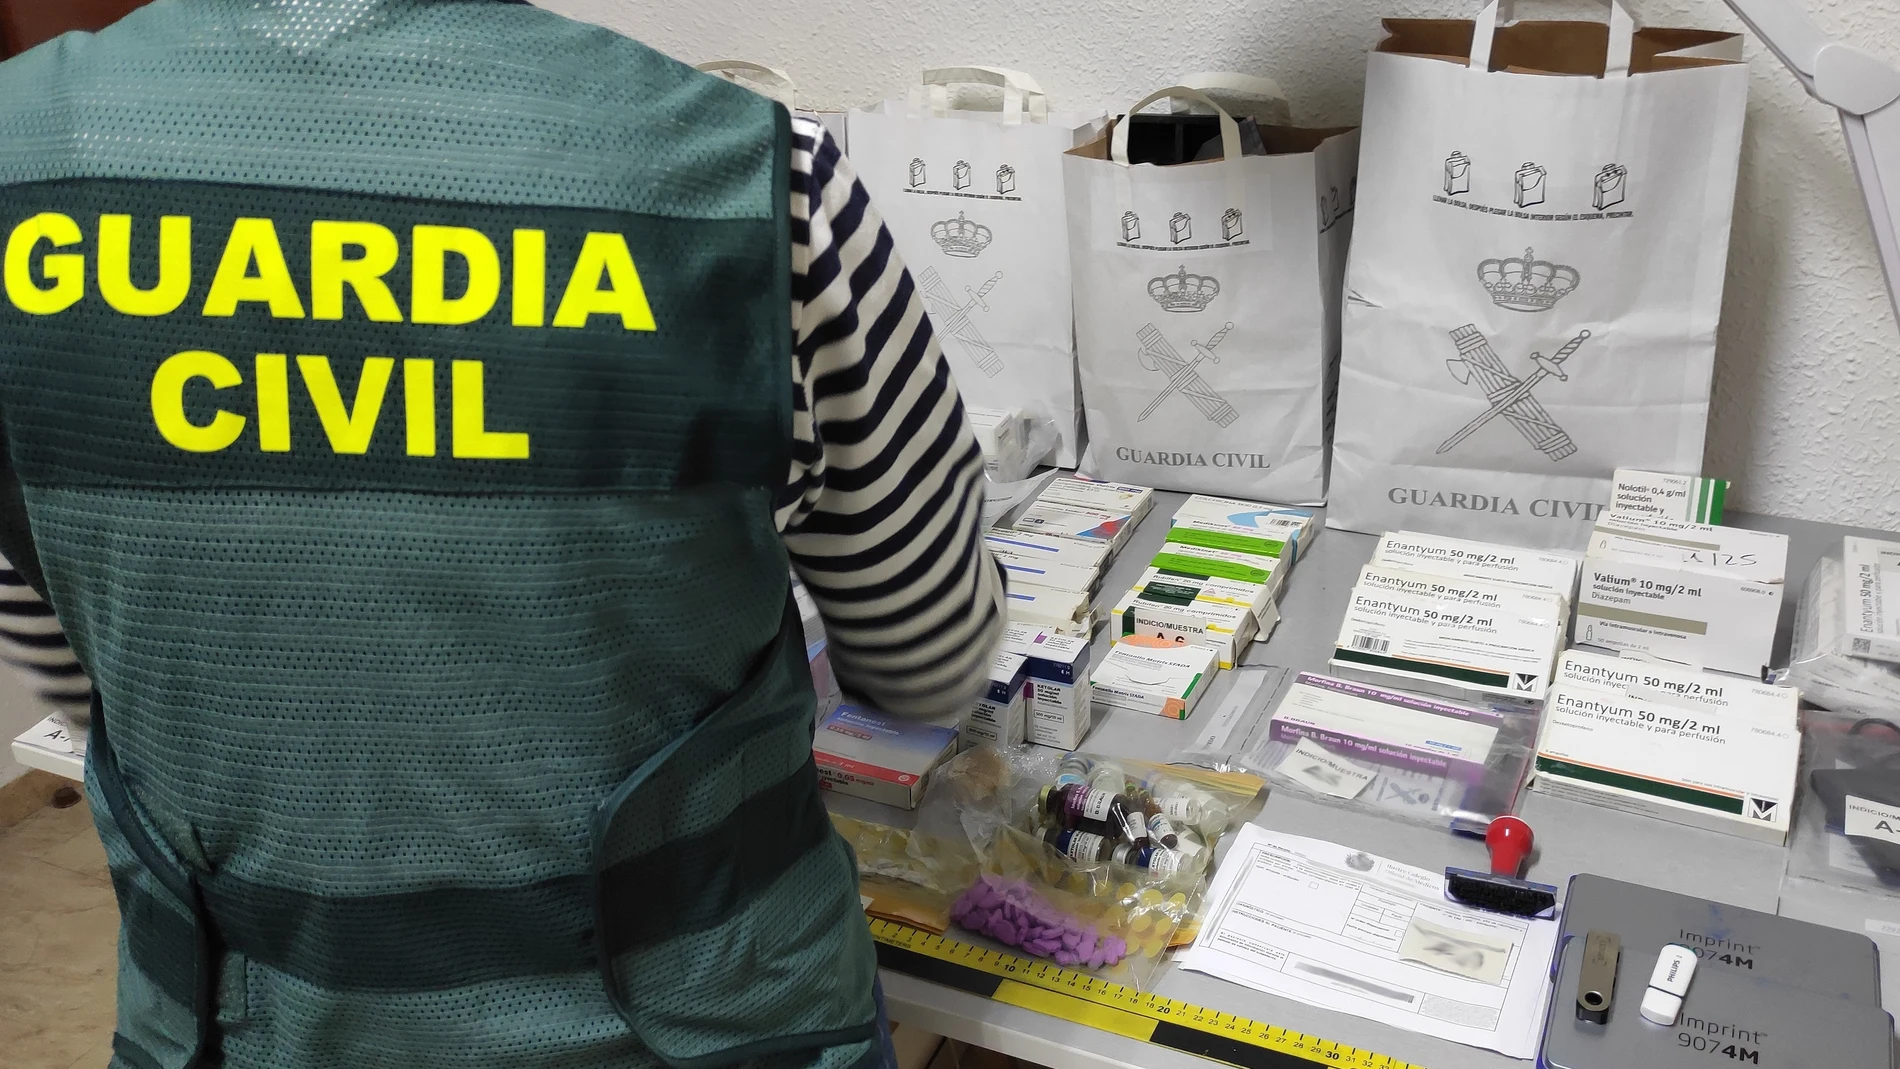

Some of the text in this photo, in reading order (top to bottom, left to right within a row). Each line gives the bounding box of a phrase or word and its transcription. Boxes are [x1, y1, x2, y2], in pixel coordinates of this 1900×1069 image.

[4, 212, 657, 331] GUARDIA
[150, 350, 529, 459] CIVIL
[1116, 446, 1271, 470] GUARDIA CIVIL
[1388, 487, 1520, 516] GUARDIA
[1616, 492, 1653, 503] solución
[1650, 486, 1665, 496] 0,4
[1665, 489, 1687, 499] g/ml
[1615, 501, 1665, 515] inyectable y
[1385, 548, 1415, 558] solución
[1416, 553, 1455, 563] inyectable
[1462, 559, 1481, 567] para
[1481, 562, 1519, 572] perfusión
[1386, 540, 1516, 565] Enantyum 50 mg/2 ml
[1205, 582, 1255, 594] comprimidos
[1363, 580, 1395, 591] solución
[1396, 587, 1436, 599] inyectable
[1443, 595, 1461, 604] para
[1462, 597, 1501, 609] perfusión
[1364, 572, 1498, 602] Enantyum 50 mg/2 ml
[1591, 591, 1631, 605] Diazepam
[1592, 583, 1665, 601] solución inyectable
[1639, 579, 1653, 590] 10
[1655, 583, 1685, 596] mg/2
[1687, 588, 1702, 597] ml
[1186, 608, 1237, 620] comprimidos
[1354, 605, 1387, 616] solución
[1388, 612, 1430, 624] inyectable
[1437, 621, 1456, 629] para
[1457, 623, 1498, 634] perfusión
[1355, 595, 1493, 627] Enantyum 50 mg/2 ml
[1136, 617, 1204, 635] INDICIO/MUESTRA
[1563, 671, 1601, 685] solución
[1564, 660, 1723, 698] Enantyum 50 mg/2 ml
[1307, 676, 1335, 687] Morfina
[1344, 684, 1366, 694] Braun
[1379, 693, 1403, 702] mg/ml
[1403, 697, 1432, 709] solución
[1432, 704, 1470, 717] inyectable
[841, 711, 886, 727] Fentanest
[1555, 705, 1594, 719] solución
[1596, 712, 1645, 729] inyectable
[1654, 726, 1676, 736] para
[1679, 730, 1726, 745] perfusión
[1557, 693, 1633, 718] Enantyum
[1637, 710, 1656, 722] 50
[1659, 716, 1697, 730] mg/2
[1701, 725, 1721, 735] ml
[1280, 724, 1447, 768] Morfina B. Braun 10 mg/ml solución inyectable
[1295, 747, 1369, 782] INDICIO/MUESTRA
[1680, 944, 1753, 970] 074M
[1666, 959, 1681, 983] PHILIPS
[1004, 963, 1016, 972] 10
[1036, 971, 1046, 980] 12
[1051, 975, 1060, 983] 13
[1066, 979, 1076, 988] 14
[1082, 983, 1091, 992] 15
[1097, 988, 1107, 996] 16
[1113, 992, 1123, 1000] 17
[1129, 997, 1139, 1005] 18
[1157, 1005, 1171, 1015] 20
[1175, 1009, 1186, 1017] 21
[1193, 1014, 1204, 1023] 22
[1208, 1018, 1219, 1026] 23
[1224, 1022, 1235, 1031] 24
[1240, 1027, 1251, 1035] 25
[1258, 1032, 1270, 1040] 26
[1275, 1036, 1287, 1044] 27
[1293, 1041, 1304, 1049] 28
[1310, 1046, 1322, 1054] 29
[1325, 1050, 1340, 1061] 30
[1345, 1055, 1356, 1063] 31
[1361, 1059, 1374, 1068] 32
[1678, 1032, 1760, 1066] 9074M
